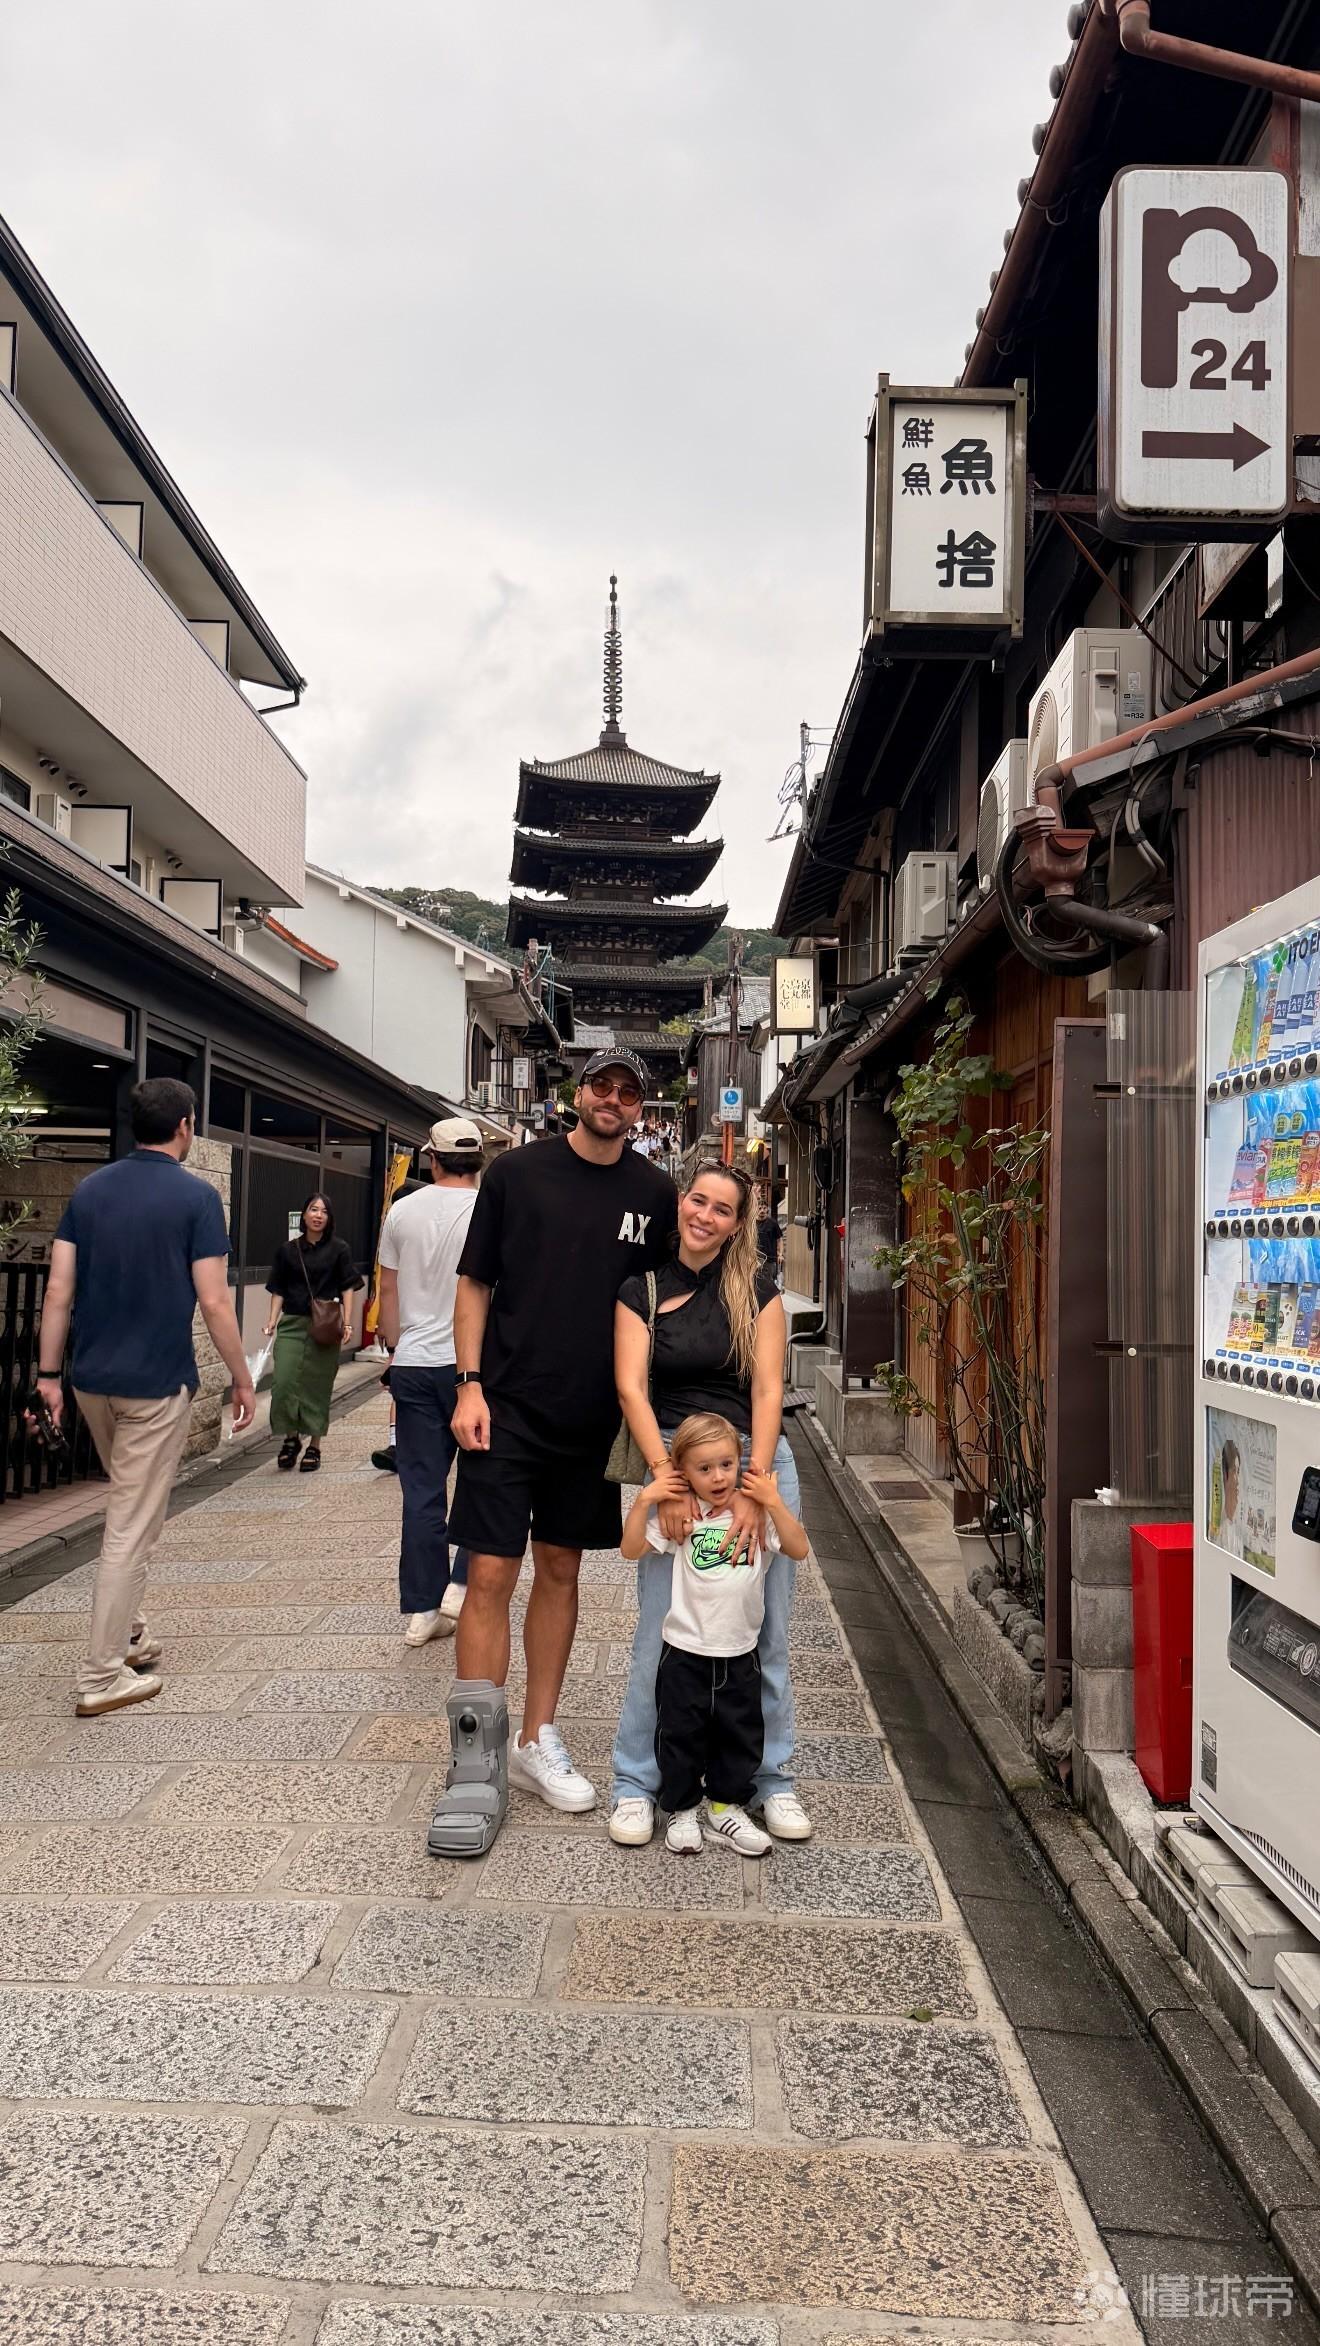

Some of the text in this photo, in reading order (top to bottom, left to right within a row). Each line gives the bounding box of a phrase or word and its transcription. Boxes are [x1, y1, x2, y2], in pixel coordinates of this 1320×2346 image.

[1189, 338, 1271, 391] 24
[901, 417, 934, 496] 鮮魚
[1288, 937, 1309, 965] ITO
[618, 1211, 651, 1245] AX
